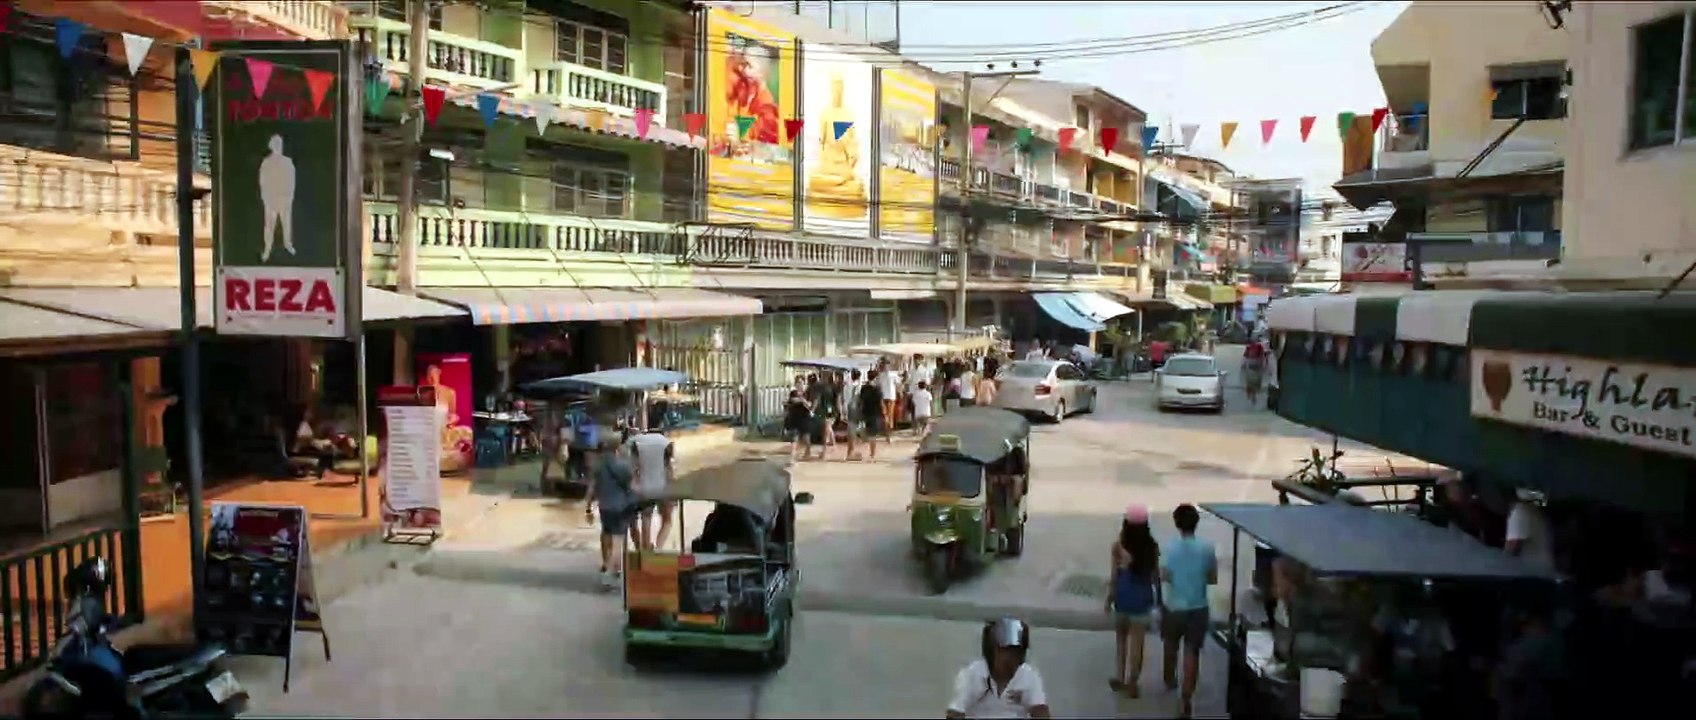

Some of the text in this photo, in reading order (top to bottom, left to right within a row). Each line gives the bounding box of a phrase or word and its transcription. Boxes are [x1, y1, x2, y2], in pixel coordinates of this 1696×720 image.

[225, 278, 336, 312] REZA
[1522, 364, 1696, 418] Highla
[1533, 401, 1692, 446] Bar & Guest
